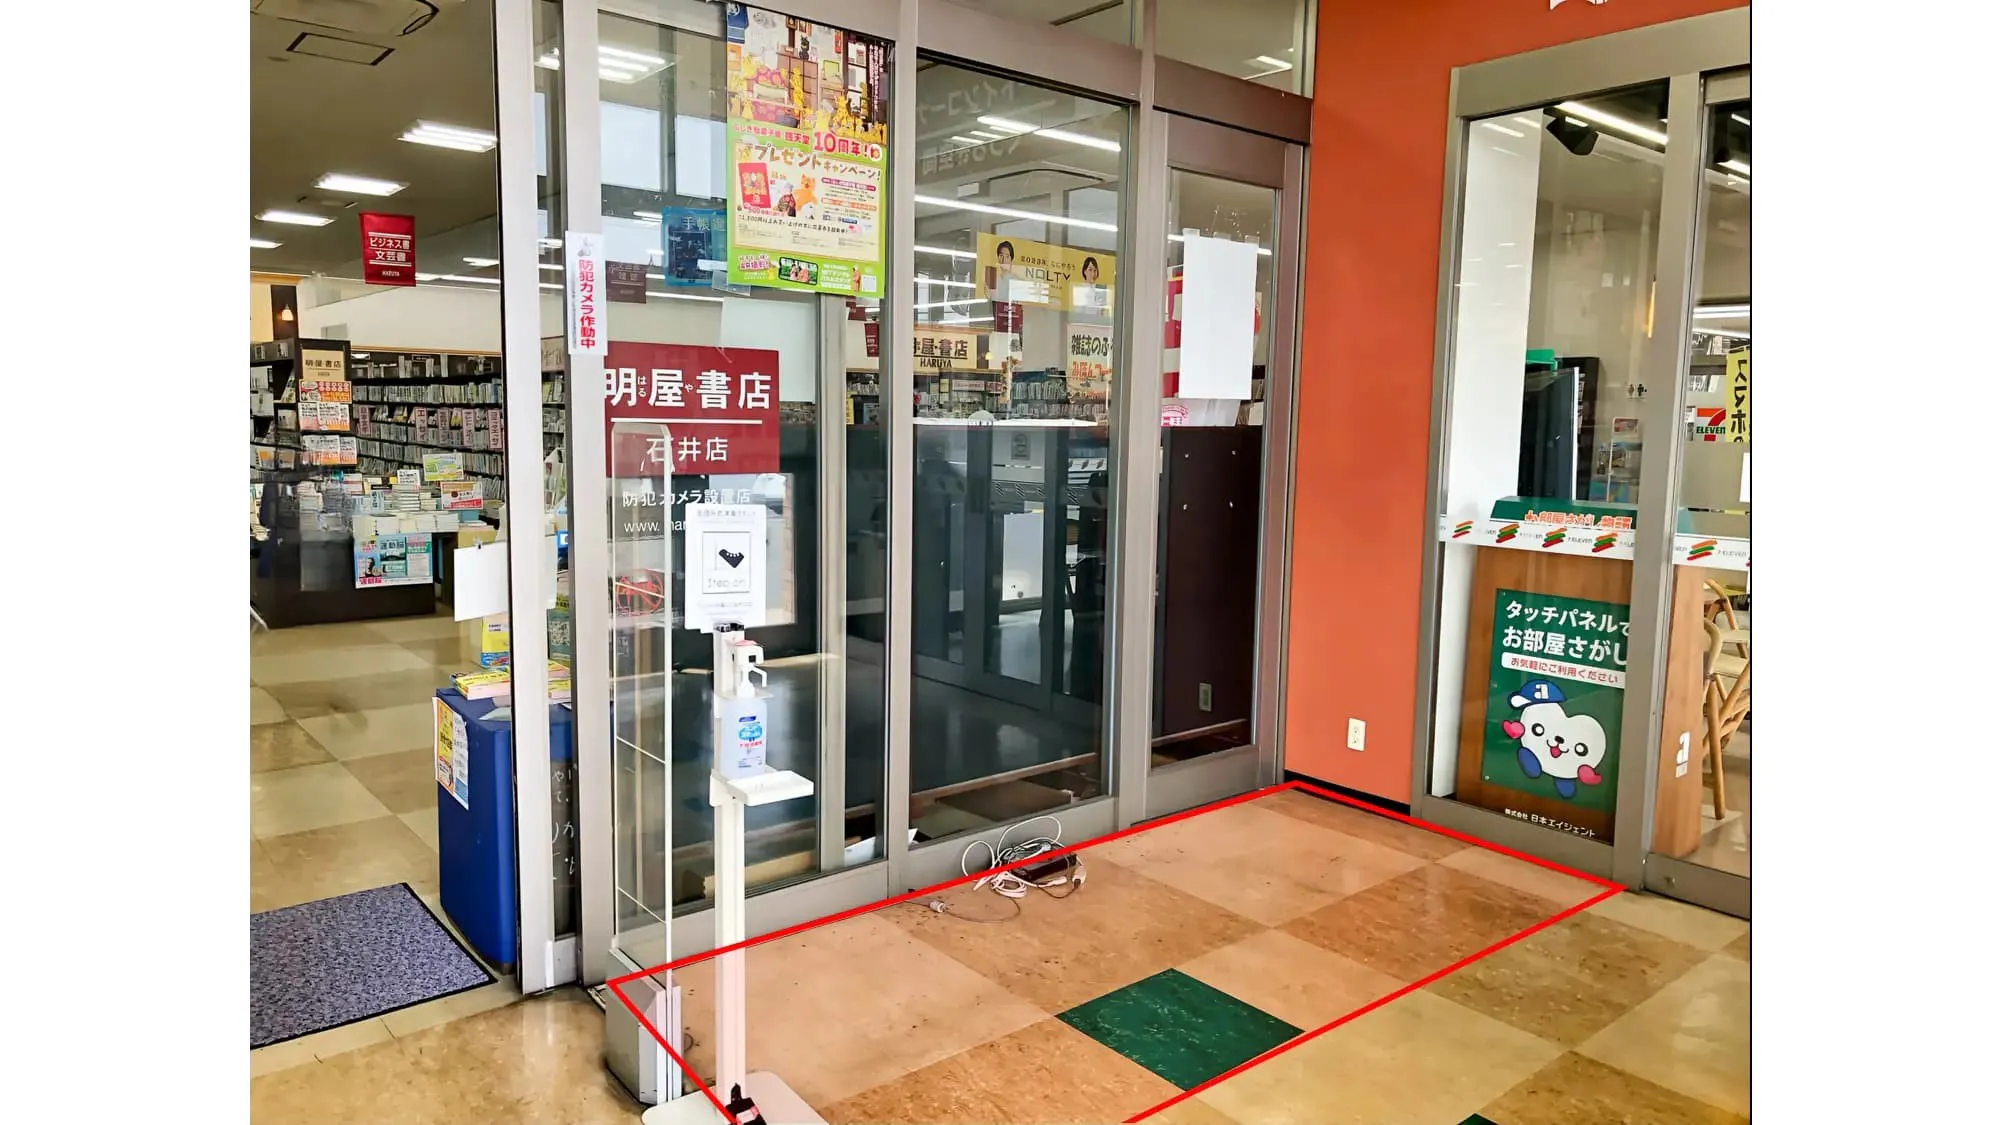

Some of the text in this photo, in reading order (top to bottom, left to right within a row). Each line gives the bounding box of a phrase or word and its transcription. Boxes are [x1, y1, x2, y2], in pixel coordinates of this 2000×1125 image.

[579, 258, 596, 349] 防犯カメラ作動中
[920, 357, 952, 368] HARUYA
[646, 437, 729, 462] 石井店
[1502, 625, 1628, 666] お部屋さがし
[1510, 656, 1619, 684] お気軽にご利用ください
[1505, 807, 1597, 838] 株式会社 日本エイジェント
